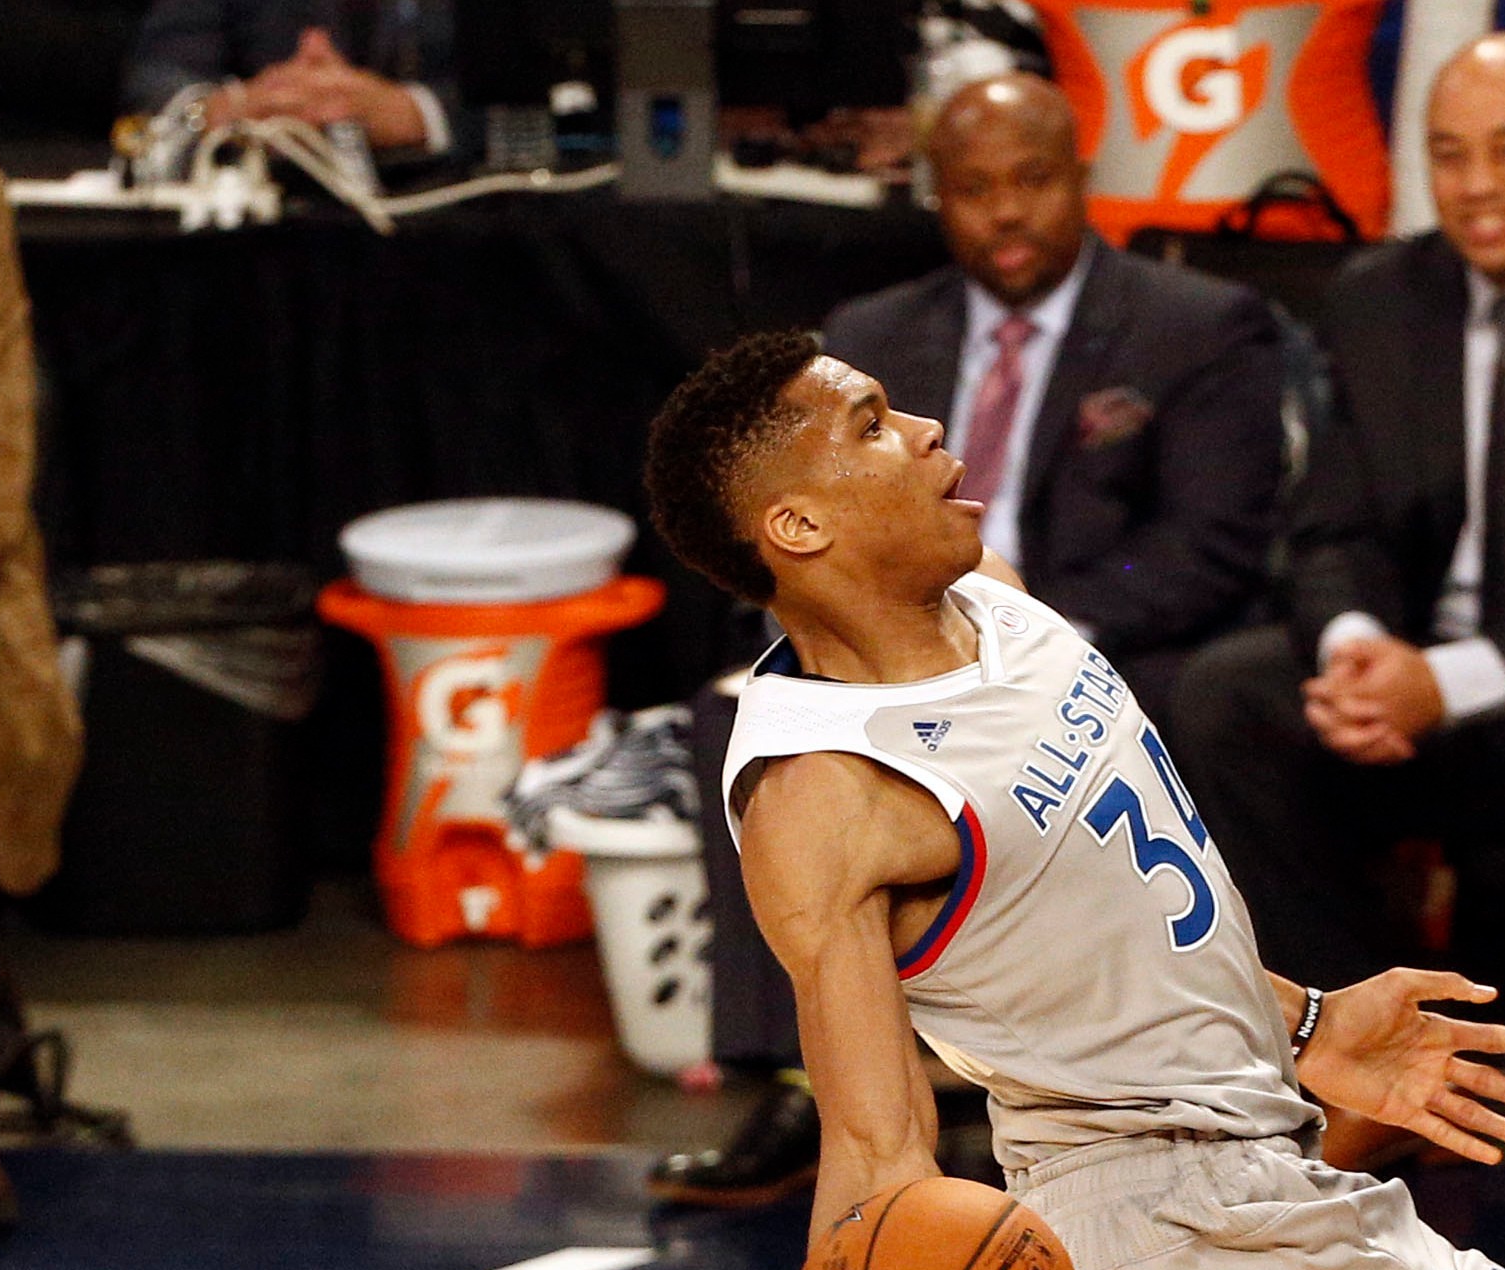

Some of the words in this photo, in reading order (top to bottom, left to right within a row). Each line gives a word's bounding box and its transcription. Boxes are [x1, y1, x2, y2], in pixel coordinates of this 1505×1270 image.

[1144, 25, 1242, 134] G
[418, 657, 508, 751] G
[1297, 1000, 1319, 1039] Never
